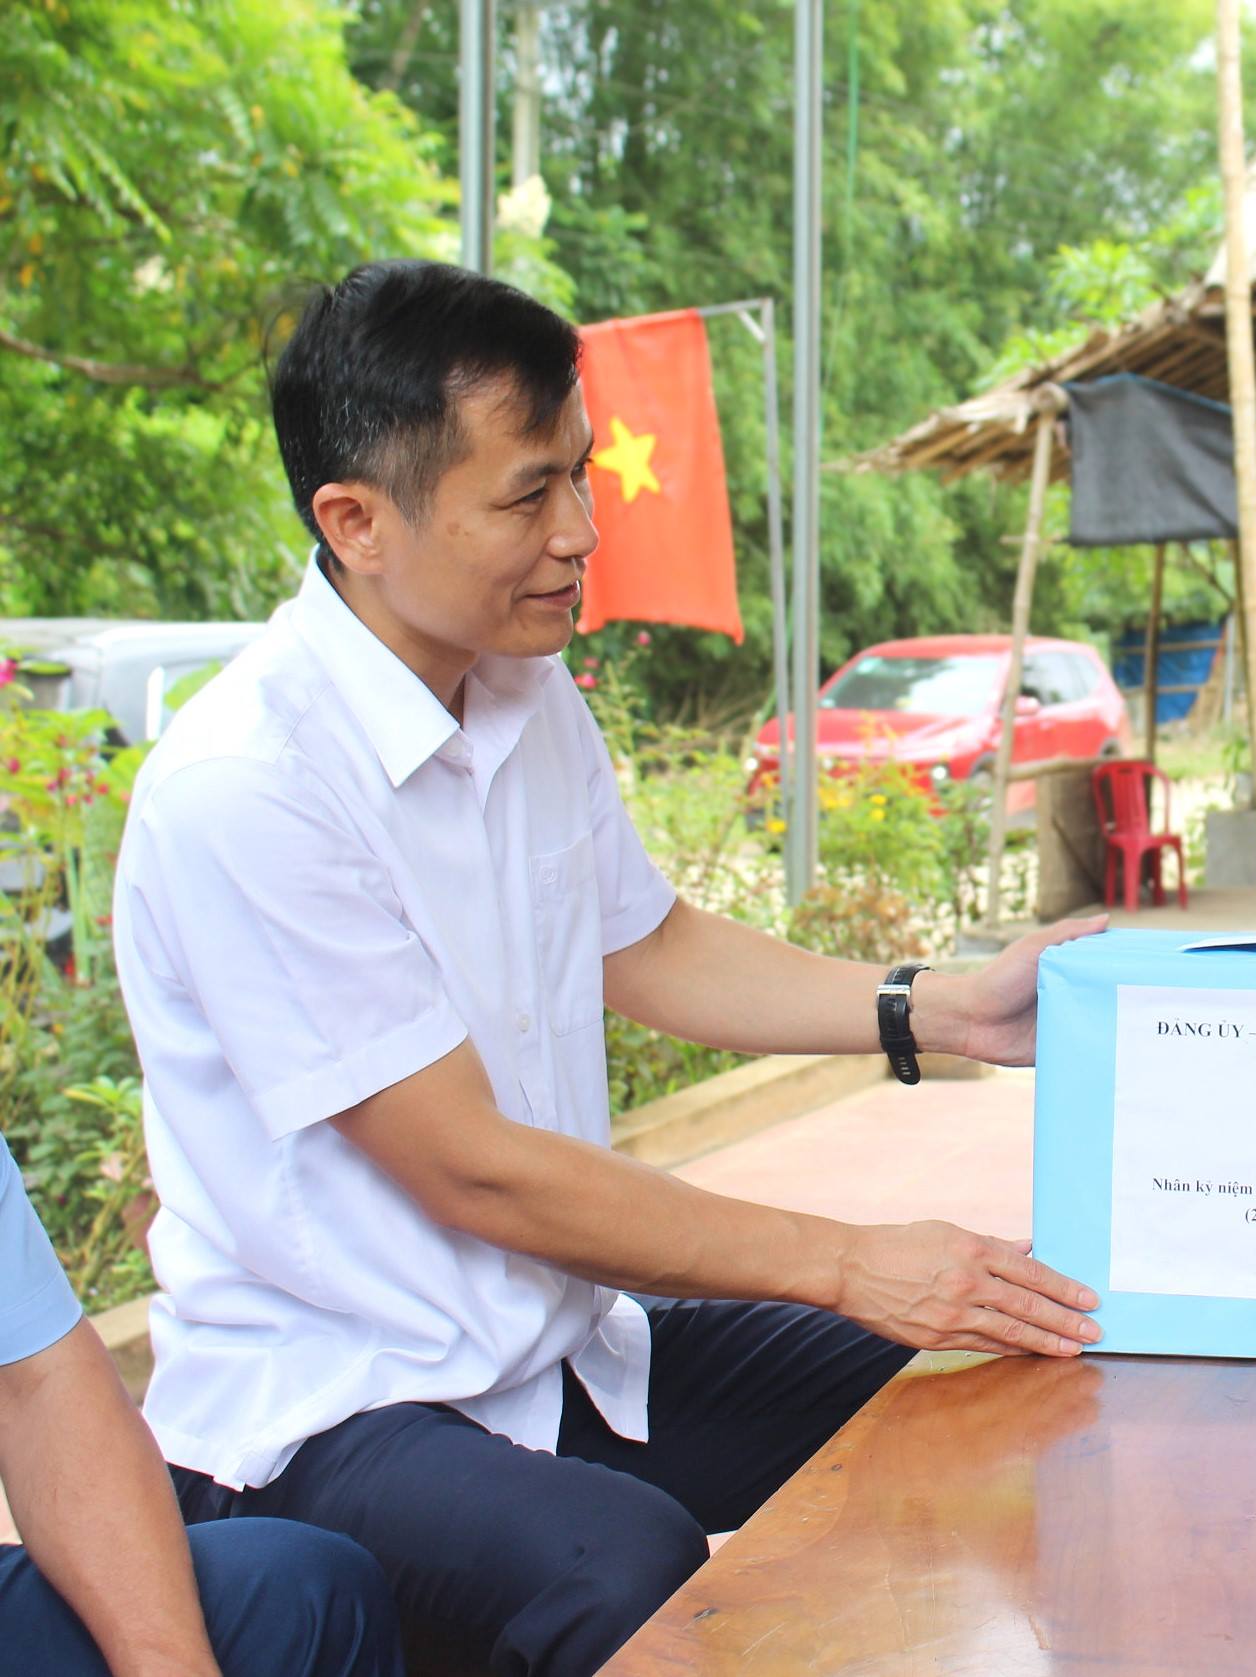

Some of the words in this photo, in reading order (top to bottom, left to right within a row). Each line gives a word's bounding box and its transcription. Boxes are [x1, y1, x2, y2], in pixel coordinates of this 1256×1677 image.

[1157, 1018, 1212, 1038] ĐẢNG
[1218, 1019, 1244, 1039] ỦY
[1152, 1178, 1190, 1192] Nhân
[1196, 1180, 1213, 1196] kỷ
[1218, 1181, 1253, 1197] niệm
